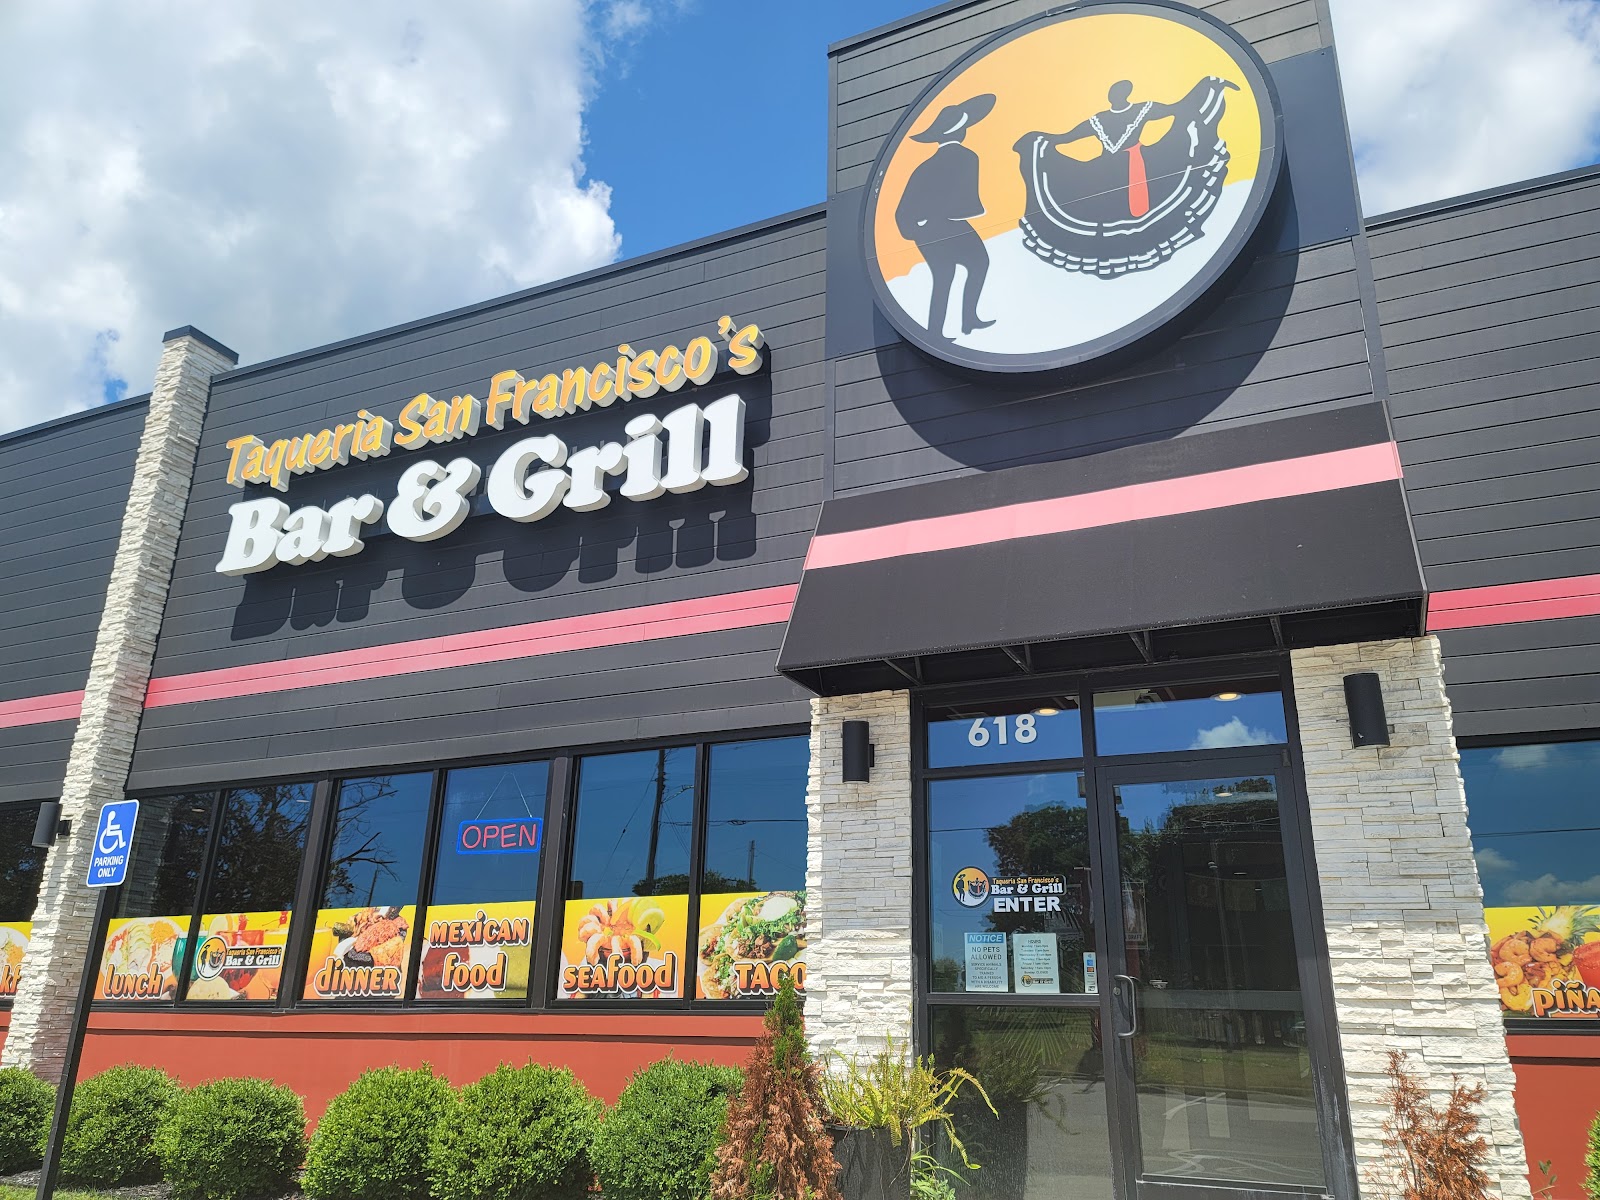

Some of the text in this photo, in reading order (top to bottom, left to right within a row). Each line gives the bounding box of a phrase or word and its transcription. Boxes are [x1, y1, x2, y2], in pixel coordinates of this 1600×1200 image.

[394, 393, 477, 448] San
[486, 316, 762, 428] Francisco's
[216, 394, 749, 576] Bar & Grill
[968, 714, 1037, 747] 618
[462, 823, 537, 849] OPEN
[94, 855, 124, 867] PARKING
[97, 867, 116, 878] ONLY
[991, 883, 1063, 894] Bar & Grill
[994, 896, 1061, 912] ENTER
[969, 934, 1002, 942] NOTICE
[225, 955, 280, 965] Bar & Grill
